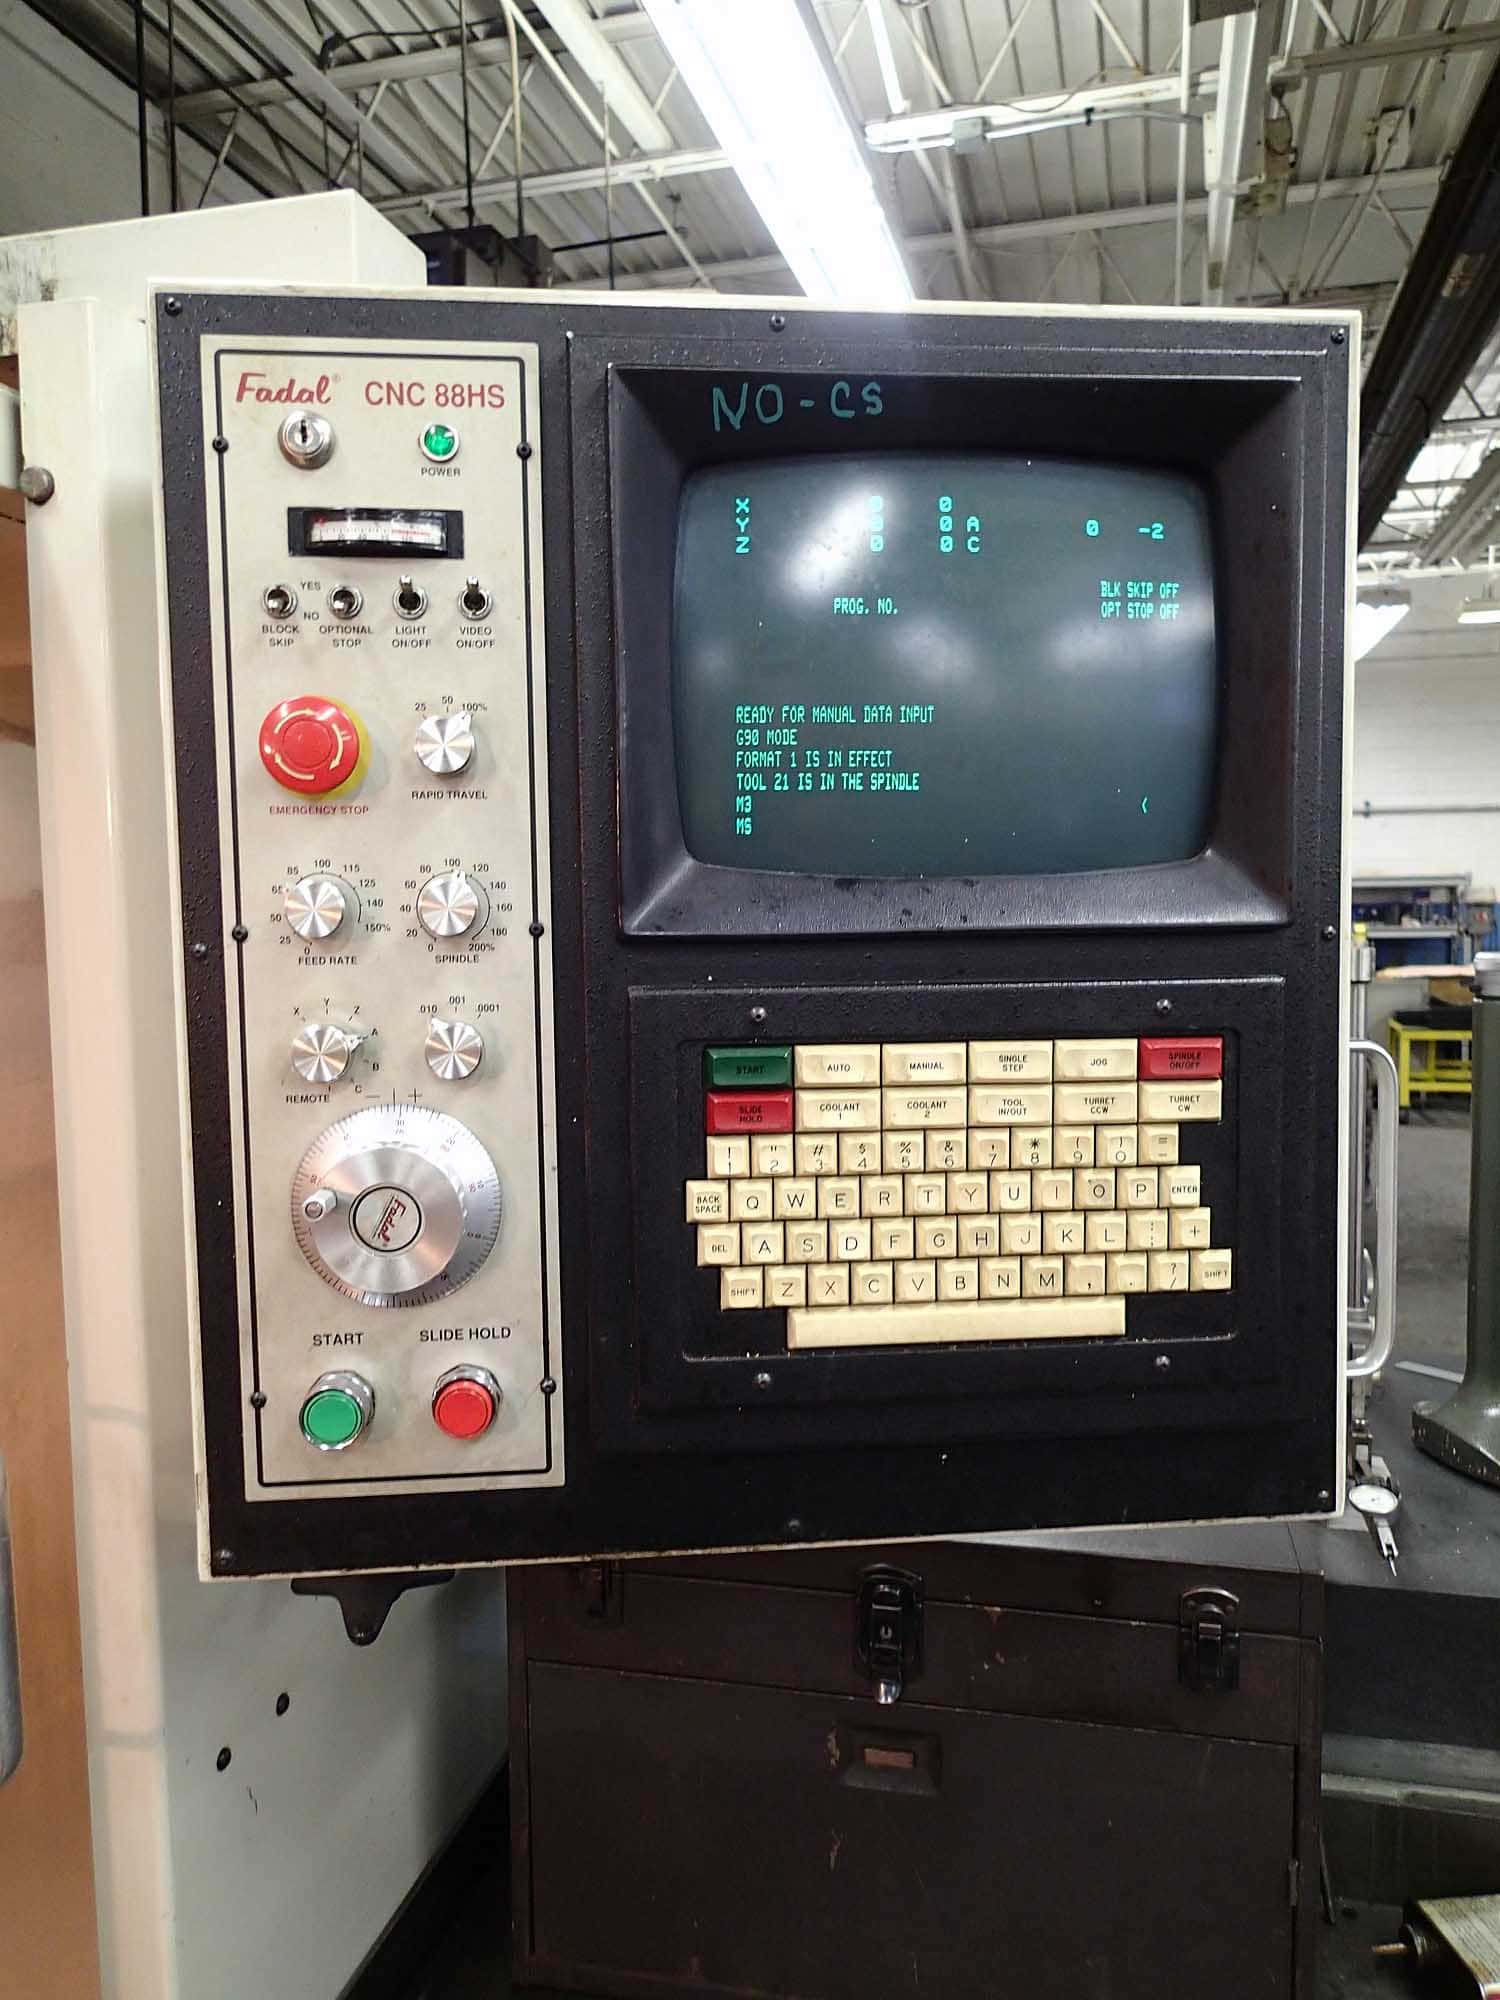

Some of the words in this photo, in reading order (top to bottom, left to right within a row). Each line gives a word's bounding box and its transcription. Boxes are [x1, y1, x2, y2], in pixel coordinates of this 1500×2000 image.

[236, 372, 332, 405] Fadal
[365, 382, 425, 407] CNC
[435, 383, 505, 408] 88HS
[421, 467, 460, 476] POWER
[735, 498, 750, 513] X
[939, 497, 953, 512] 0
[735, 517, 750, 533] Y
[939, 516, 952, 532] 0
[967, 516, 980, 532] A
[1086, 520, 1099, 537] 0
[1138, 522, 1164, 540] -2
[735, 536, 750, 553] Z
[940, 536, 953, 552] 0
[967, 536, 980, 552] C
[300, 581, 321, 591] YES
[1100, 580, 1121, 598] BLK
[1127, 581, 1154, 598] SKIP
[1159, 582, 1179, 599] OFF
[833, 598, 871, 615] PROG.
[877, 598, 898, 615] NO.
[1100, 601, 1121, 618] OPT
[1127, 602, 1154, 619] STOP
[1159, 603, 1179, 620] OFF
[303, 612, 320, 621] NO
[262, 625, 300, 634] BLOCK
[319, 625, 373, 634] OPTIONAL
[395, 626, 426, 636] LIGHT
[459, 626, 492, 636] VIDEO
[269, 638, 294, 648] SKIP
[333, 638, 362, 648] STOP
[392, 639, 432, 648] ON/OFF
[456, 640, 496, 649] ON/OFF
[442, 696, 453, 704] 50
[415, 703, 426, 711] 25
[462, 703, 487, 712] 100%
[736, 705, 774, 723] READY
[782, 705, 805, 723] FOR
[812, 705, 856, 723] MANUAL
[863, 705, 893, 723] DATA
[899, 705, 934, 723] INPUT
[736, 729, 759, 746] G90
[767, 729, 798, 745] MODE
[736, 751, 782, 767] FORMAT
[790, 751, 797, 767] 1
[805, 751, 820, 767] IS
[827, 751, 842, 767] IN
[848, 751, 893, 767] EFFECT
[736, 773, 767, 790] TOOL
[774, 773, 789, 790] 21
[798, 773, 812, 790] IS
[820, 773, 834, 790] IN
[841, 773, 863, 790] THE
[870, 773, 920, 790] SPINDLE
[411, 790, 444, 800] RAPID
[448, 790, 487, 800] TRAVEL
[736, 795, 752, 813] M3
[269, 806, 337, 815] EMERGENCY
[340, 806, 369, 815] STOP
[314, 860, 330, 868] 100
[444, 858, 460, 867] 100
[287, 867, 298, 875] 85
[343, 864, 360, 873] 115
[420, 865, 431, 873] 80
[473, 864, 489, 872] 120
[359, 878, 376, 887] 125
[405, 881, 416, 889] 60
[490, 881, 506, 890] 140
[367, 899, 383, 907] 140
[400, 905, 411, 913] 40
[496, 904, 512, 912] 160
[270, 914, 282, 922] 50
[365, 923, 391, 933] 150%
[406, 928, 418, 937] 20
[280, 936, 291, 945] 25
[468, 943, 495, 952] 200%
[298, 956, 325, 965] FEED
[329, 956, 358, 965] RATE
[435, 955, 479, 964] SPINDLE
[998, 1055, 1028, 1063] SINGLE
[1168, 1052, 1201, 1060] SPINDLE
[909, 1062, 944, 1071] MANUAL
[1090, 1058, 1108, 1066] JOG
[736, 1065, 765, 1074] START
[827, 1063, 850, 1072] AUTO
[1002, 1064, 1024, 1072] STEP
[286, 1094, 330, 1104] REMOTE
[1002, 1098, 1024, 1107] TOOL
[1084, 1097, 1116, 1105] TURRET
[1169, 1095, 1201, 1103] TURRET
[739, 1105, 761, 1114] SLIDE
[819, 1103, 860, 1112] COOLANT
[906, 1101, 947, 1110] COOLANT
[1090, 1106, 1108, 1114] CCW
[1178, 1104, 1191, 1112] CW
[998, 1107, 1028, 1116] IN/OUT
[739, 1115, 762, 1123] HOLD
[1008, 1186, 1020, 1200] U
[1093, 1183, 1105, 1198] O
[1136, 1183, 1147, 1198] P
[1172, 1186, 1198, 1194] ENTER
[879, 1191, 890, 1206] R
[923, 1189, 933, 1204] T
[965, 1188, 976, 1202] Y
[697, 1196, 720, 1204] BACK
[746, 1195, 759, 1211] Q
[786, 1193, 805, 1208] W
[835, 1192, 846, 1208] E
[695, 1204, 722, 1214] SPACE
[976, 1232, 988, 1247] H
[1021, 1230, 1031, 1244] J
[1062, 1229, 1073, 1243] K
[1105, 1228, 1115, 1242] L
[845, 1236, 858, 1251] D
[889, 1234, 900, 1249] F
[933, 1233, 945, 1248] G
[711, 1244, 727, 1254] DEL
[758, 1239, 771, 1255] A
[802, 1238, 814, 1254] S
[1205, 1271, 1228, 1279] SHIFT
[955, 1276, 966, 1290] B
[998, 1273, 1009, 1288] N
[1039, 1272, 1055, 1288] M
[781, 1282, 793, 1297] Z
[824, 1280, 836, 1295] X
[868, 1279, 880, 1293] C
[912, 1278, 925, 1292] V
[731, 1288, 756, 1297] SHIFT
[419, 1328, 464, 1342] SLIDE
[468, 1326, 511, 1341] HOLD
[313, 1333, 364, 1346] START
